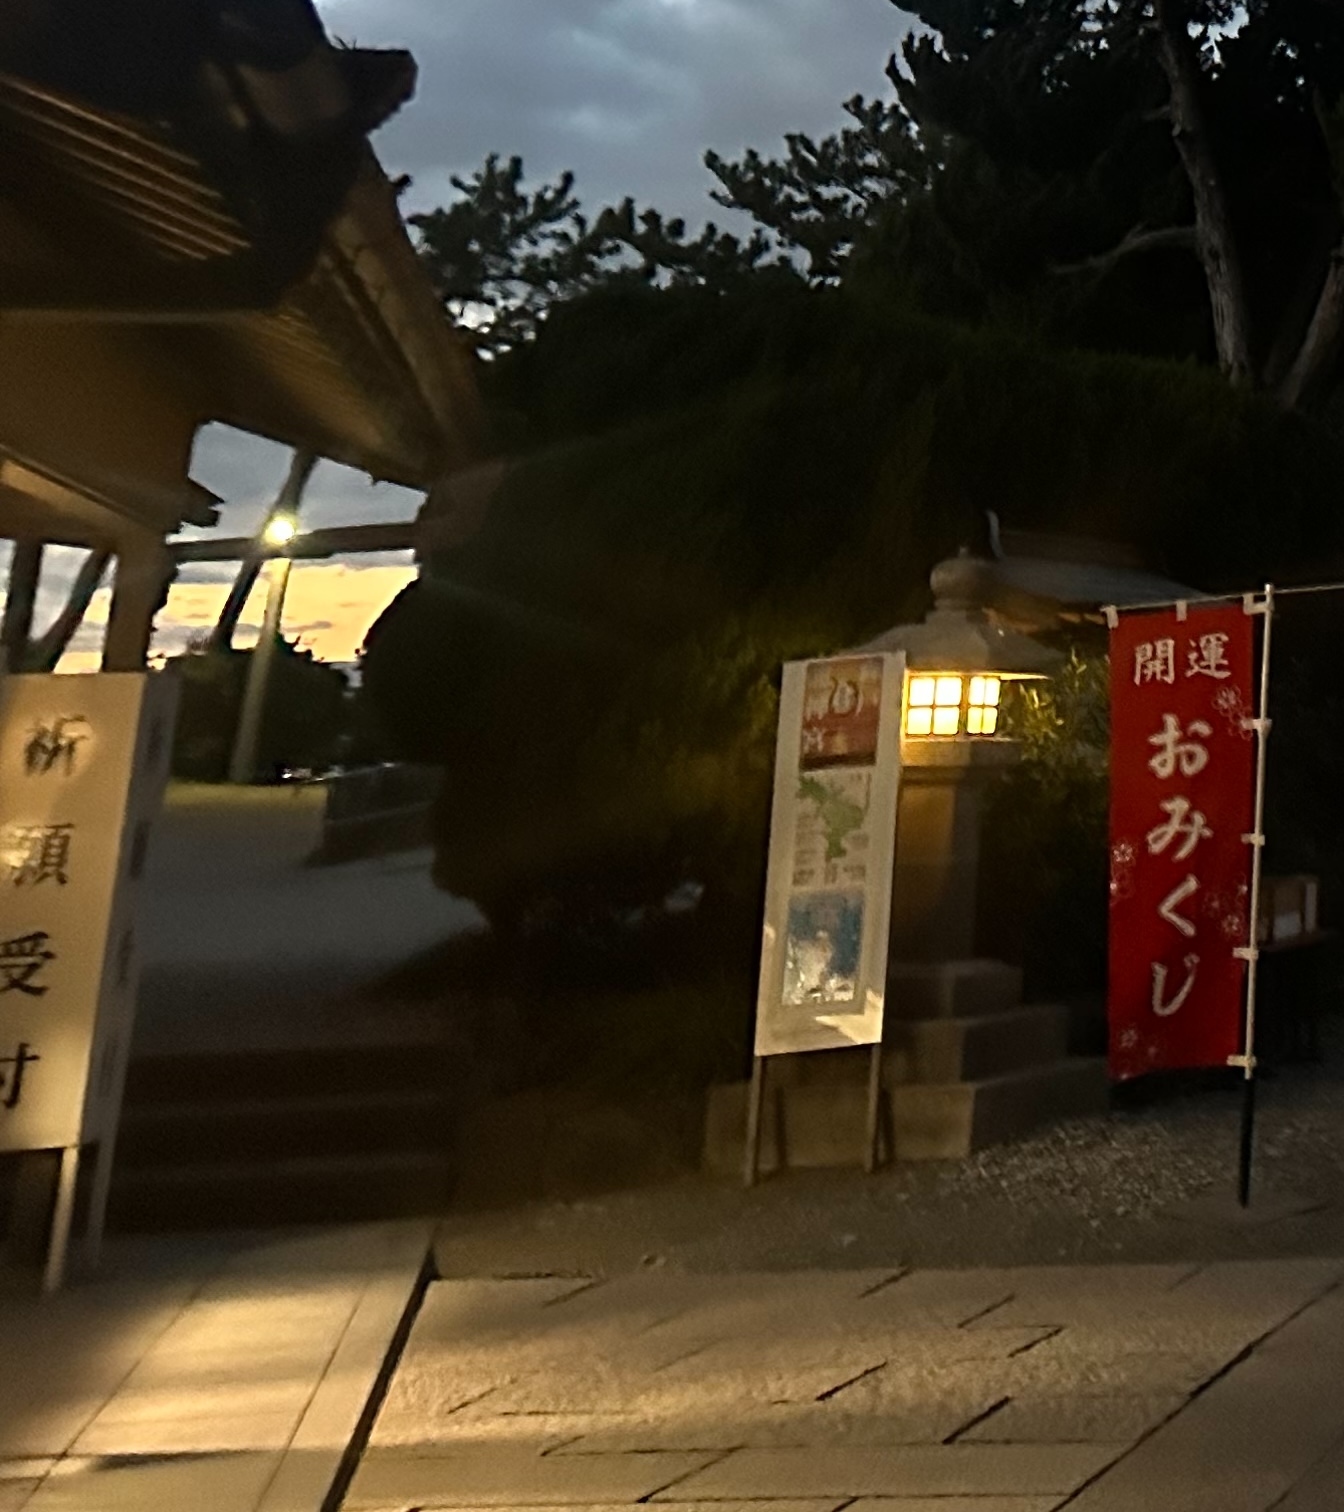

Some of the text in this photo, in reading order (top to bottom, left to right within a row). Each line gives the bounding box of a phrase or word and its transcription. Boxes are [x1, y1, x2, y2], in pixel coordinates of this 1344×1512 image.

[1133, 633, 1232, 686] 開運
[1147, 713, 1213, 1016] おみくじ
